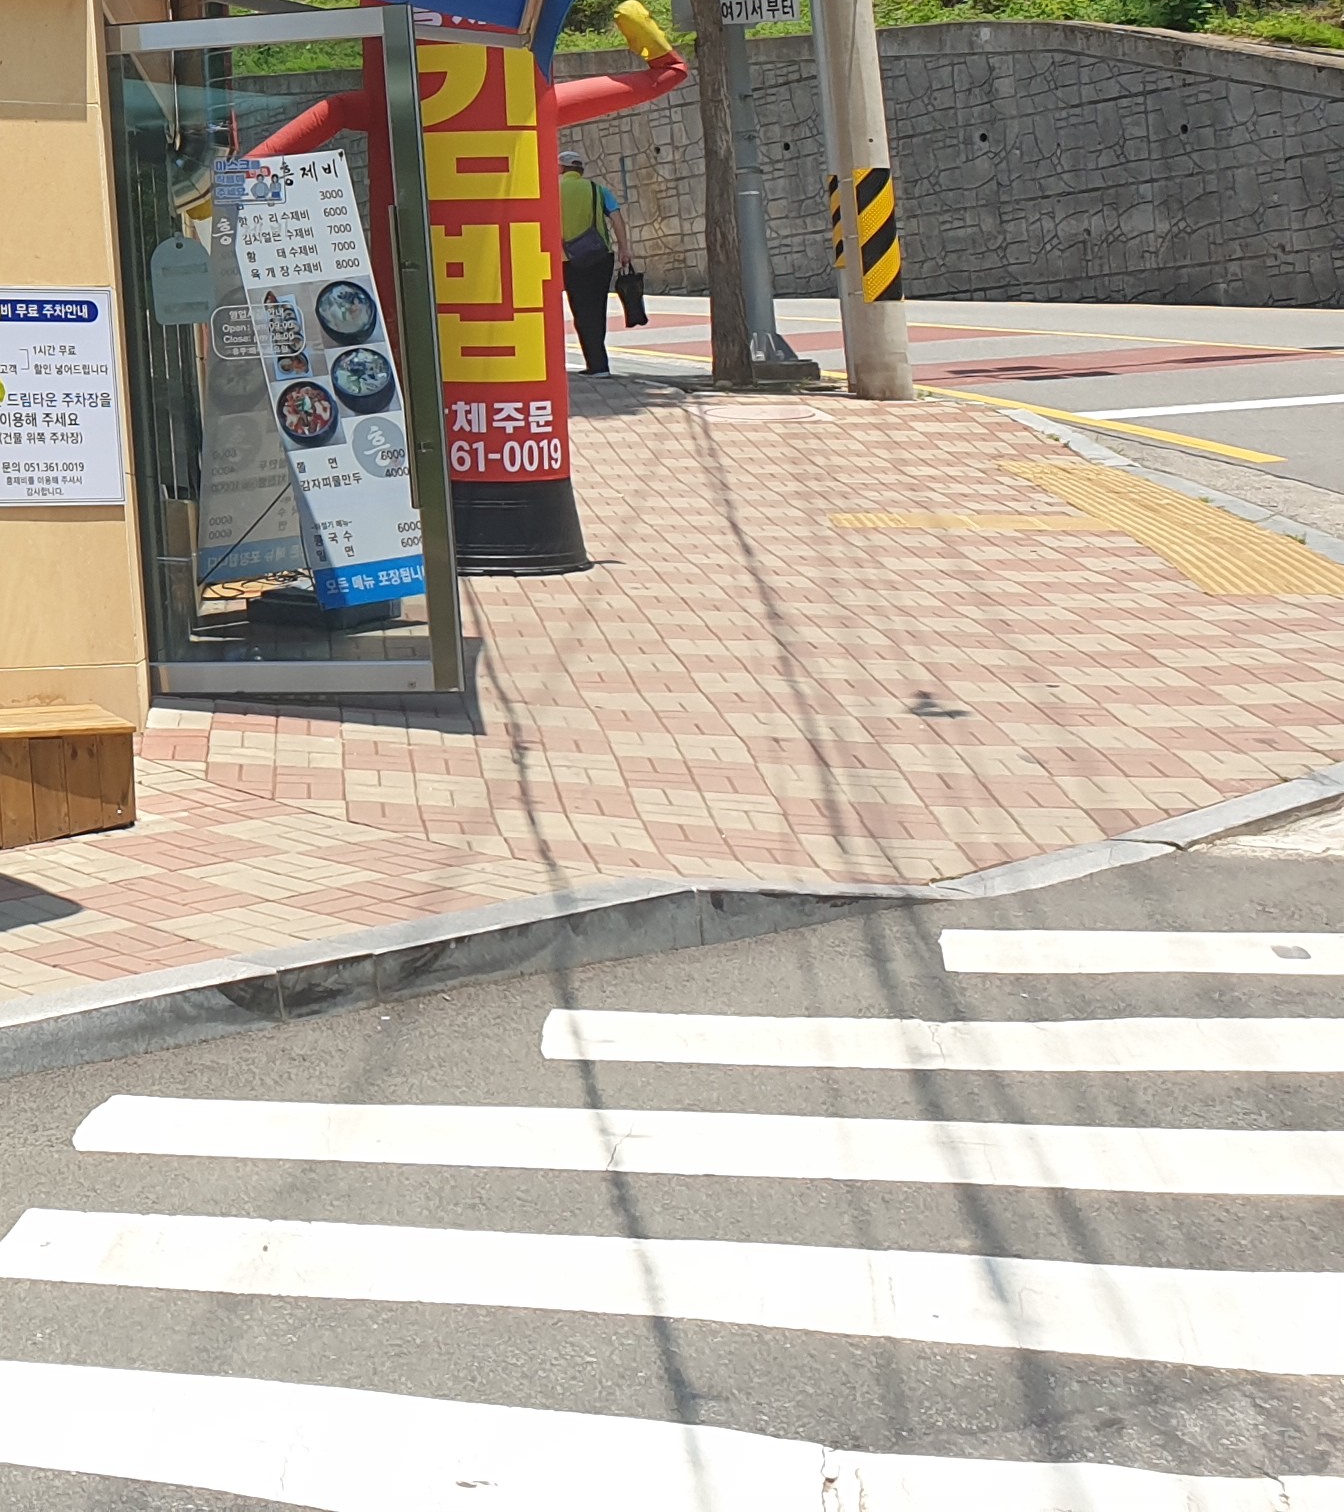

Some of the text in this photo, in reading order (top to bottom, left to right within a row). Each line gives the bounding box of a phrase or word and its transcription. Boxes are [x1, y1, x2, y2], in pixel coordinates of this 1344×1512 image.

[319, 189, 344, 201] 3000
[323, 206, 348, 218] 6000
[416, 43, 551, 382] 김밥
[327, 223, 353, 235] 7000
[289, 243, 320, 258] 수제비
[331, 240, 357, 253] 7000
[293, 261, 324, 275] 수제비
[335, 257, 361, 270] 8000
[15, 303, 39, 318] 무료
[42, 304, 89, 319] 주차안내
[32, 345, 56, 356] 1시간
[58, 345, 77, 356] 무료
[33, 364, 52, 375] 할인
[55, 363, 108, 376] 넣어드립니다
[7, 392, 58, 408] 드림타운
[61, 392, 112, 408] 주차장을
[0, 412, 80, 428] 이용해 주세요
[0, 432, 83, 445] (건물 위쪽 주차장)
[380, 448, 405, 461] 6000
[2, 461, 85, 474] 문의 051.361.0019
[301, 472, 363, 492] 감자피물만두
[352, 574, 375, 590] 메뉴
[378, 566, 425, 587] 포장됩니
